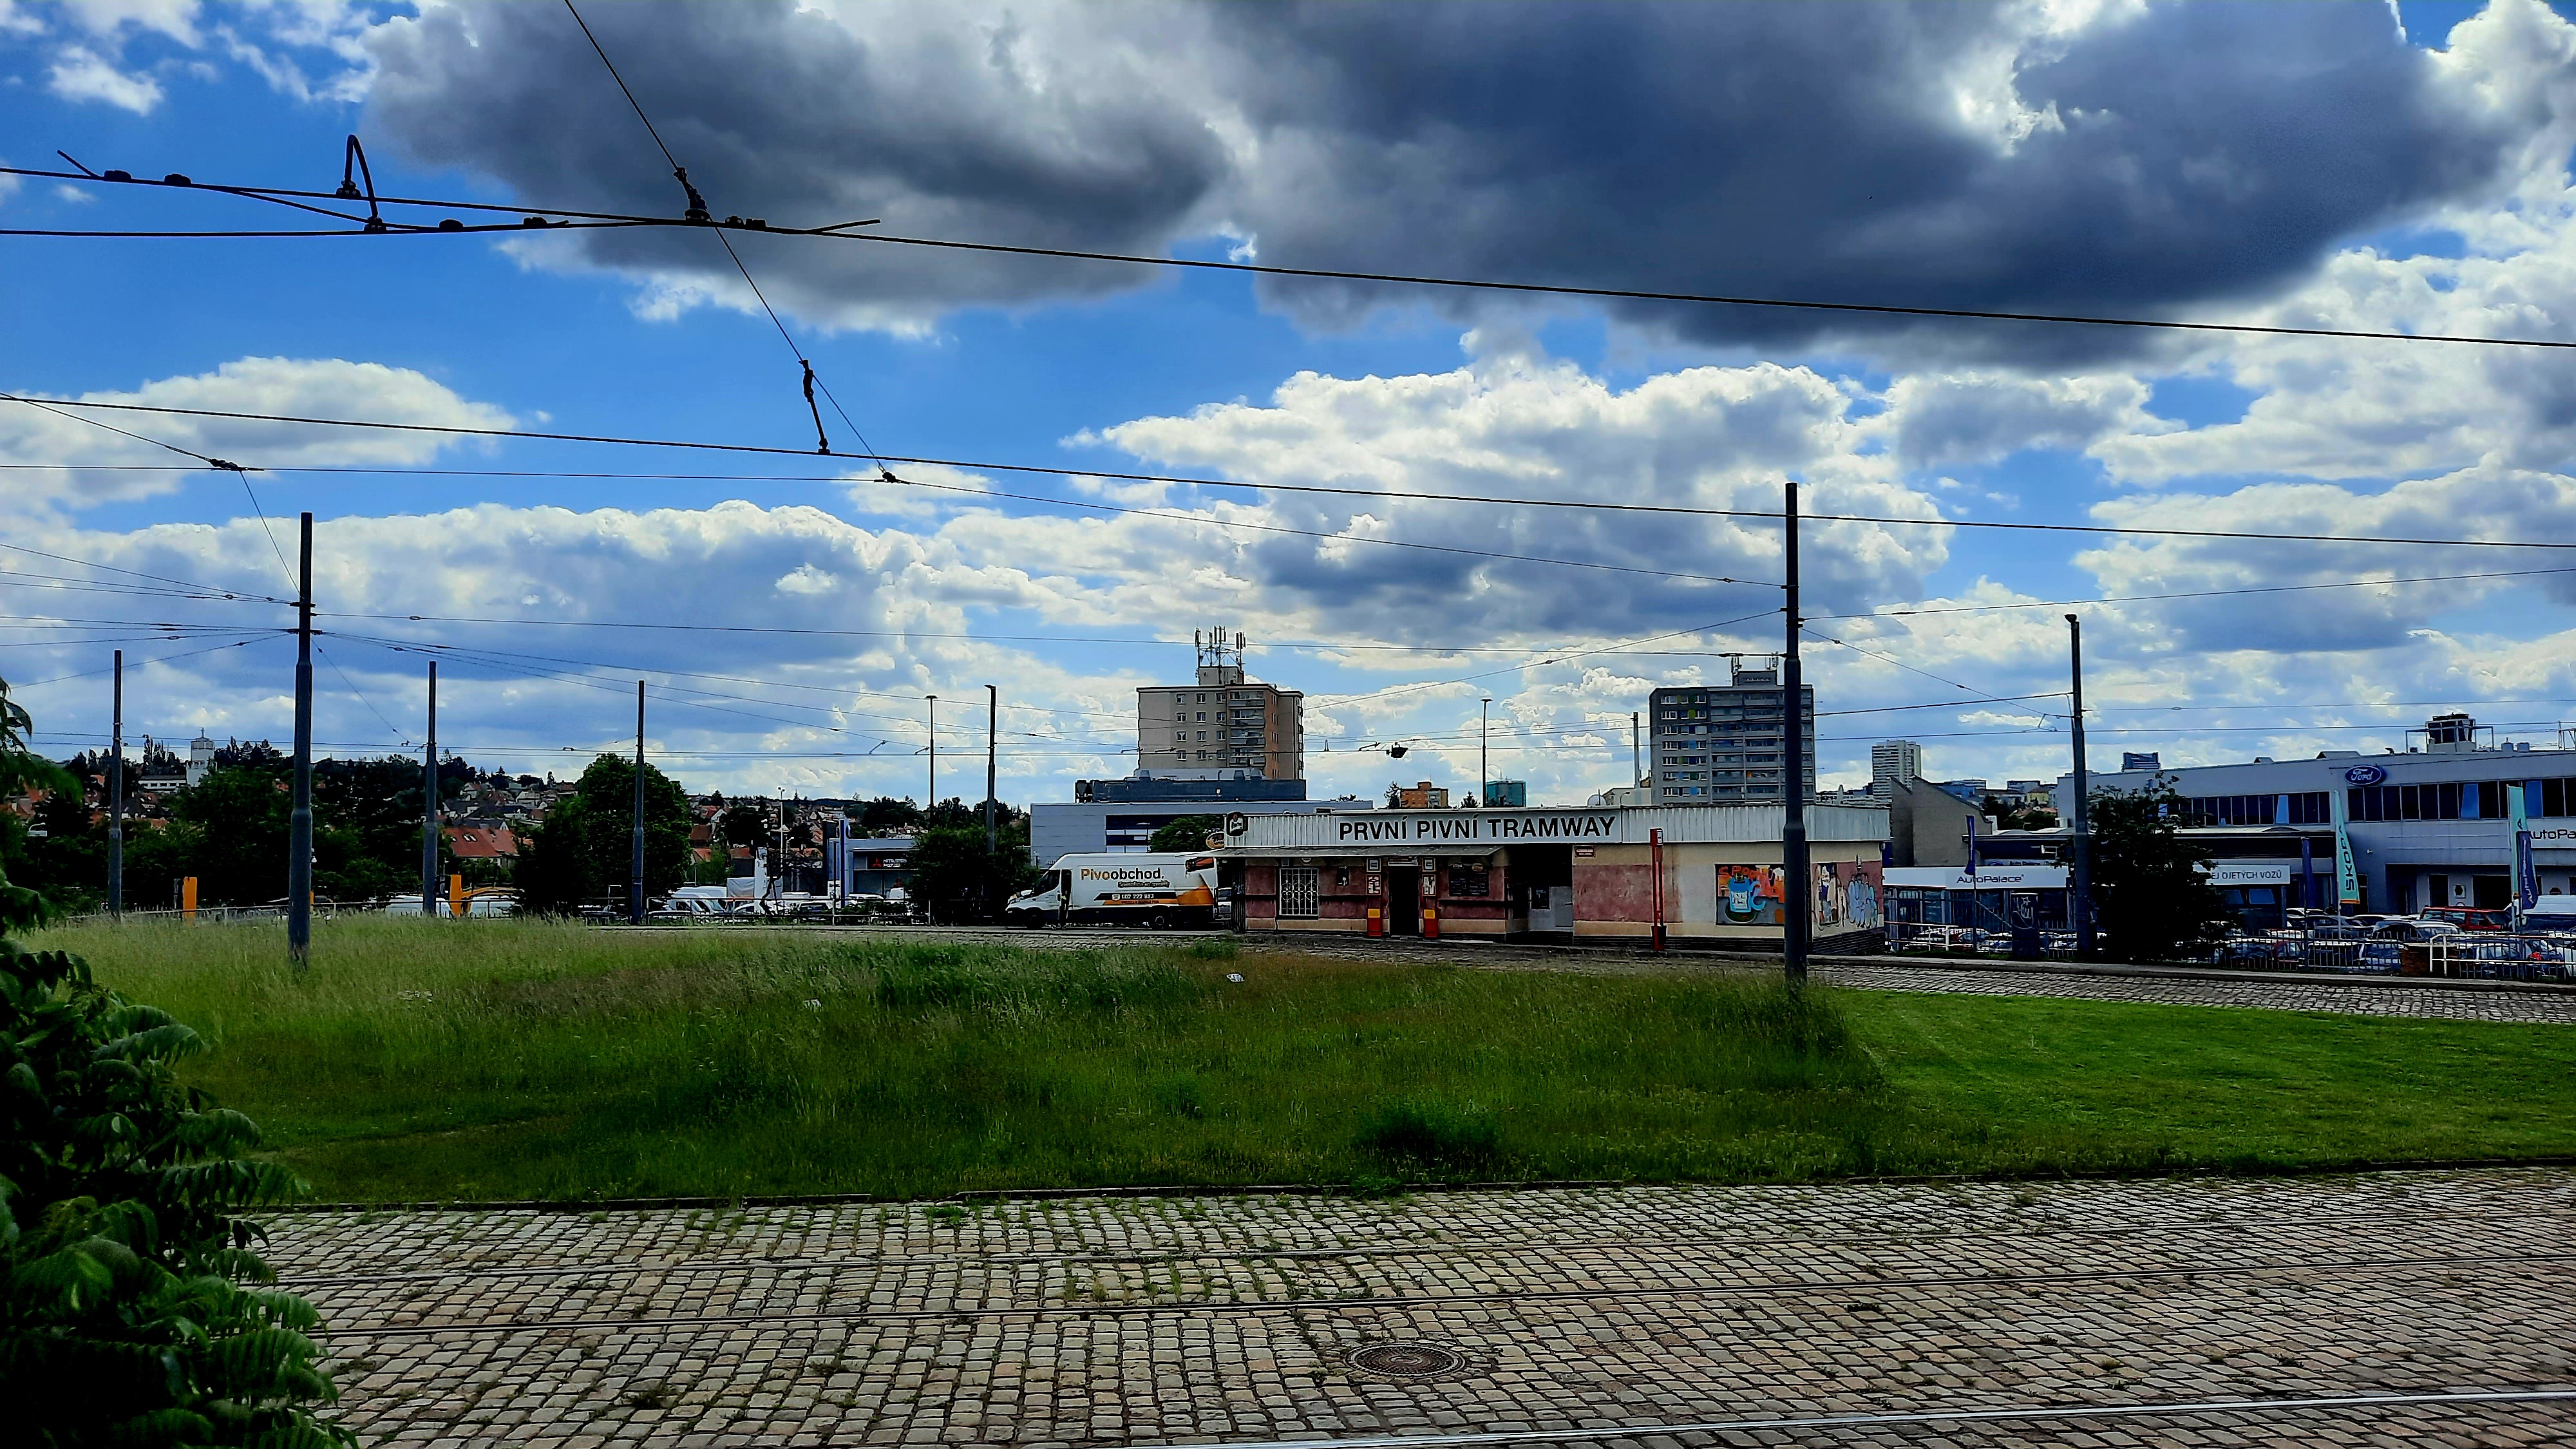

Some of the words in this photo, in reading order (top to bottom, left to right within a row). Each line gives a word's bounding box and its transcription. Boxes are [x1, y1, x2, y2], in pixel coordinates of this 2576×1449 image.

[2351, 768, 2373, 781] Ford
[1340, 817, 1408, 840] PRVNÍ
[1417, 815, 1478, 839] PIVNÍ
[1488, 816, 1615, 837] TRAMWAY
[2222, 870, 2258, 878] OJETÝCH
[2260, 869, 2282, 878] VOZŮ
